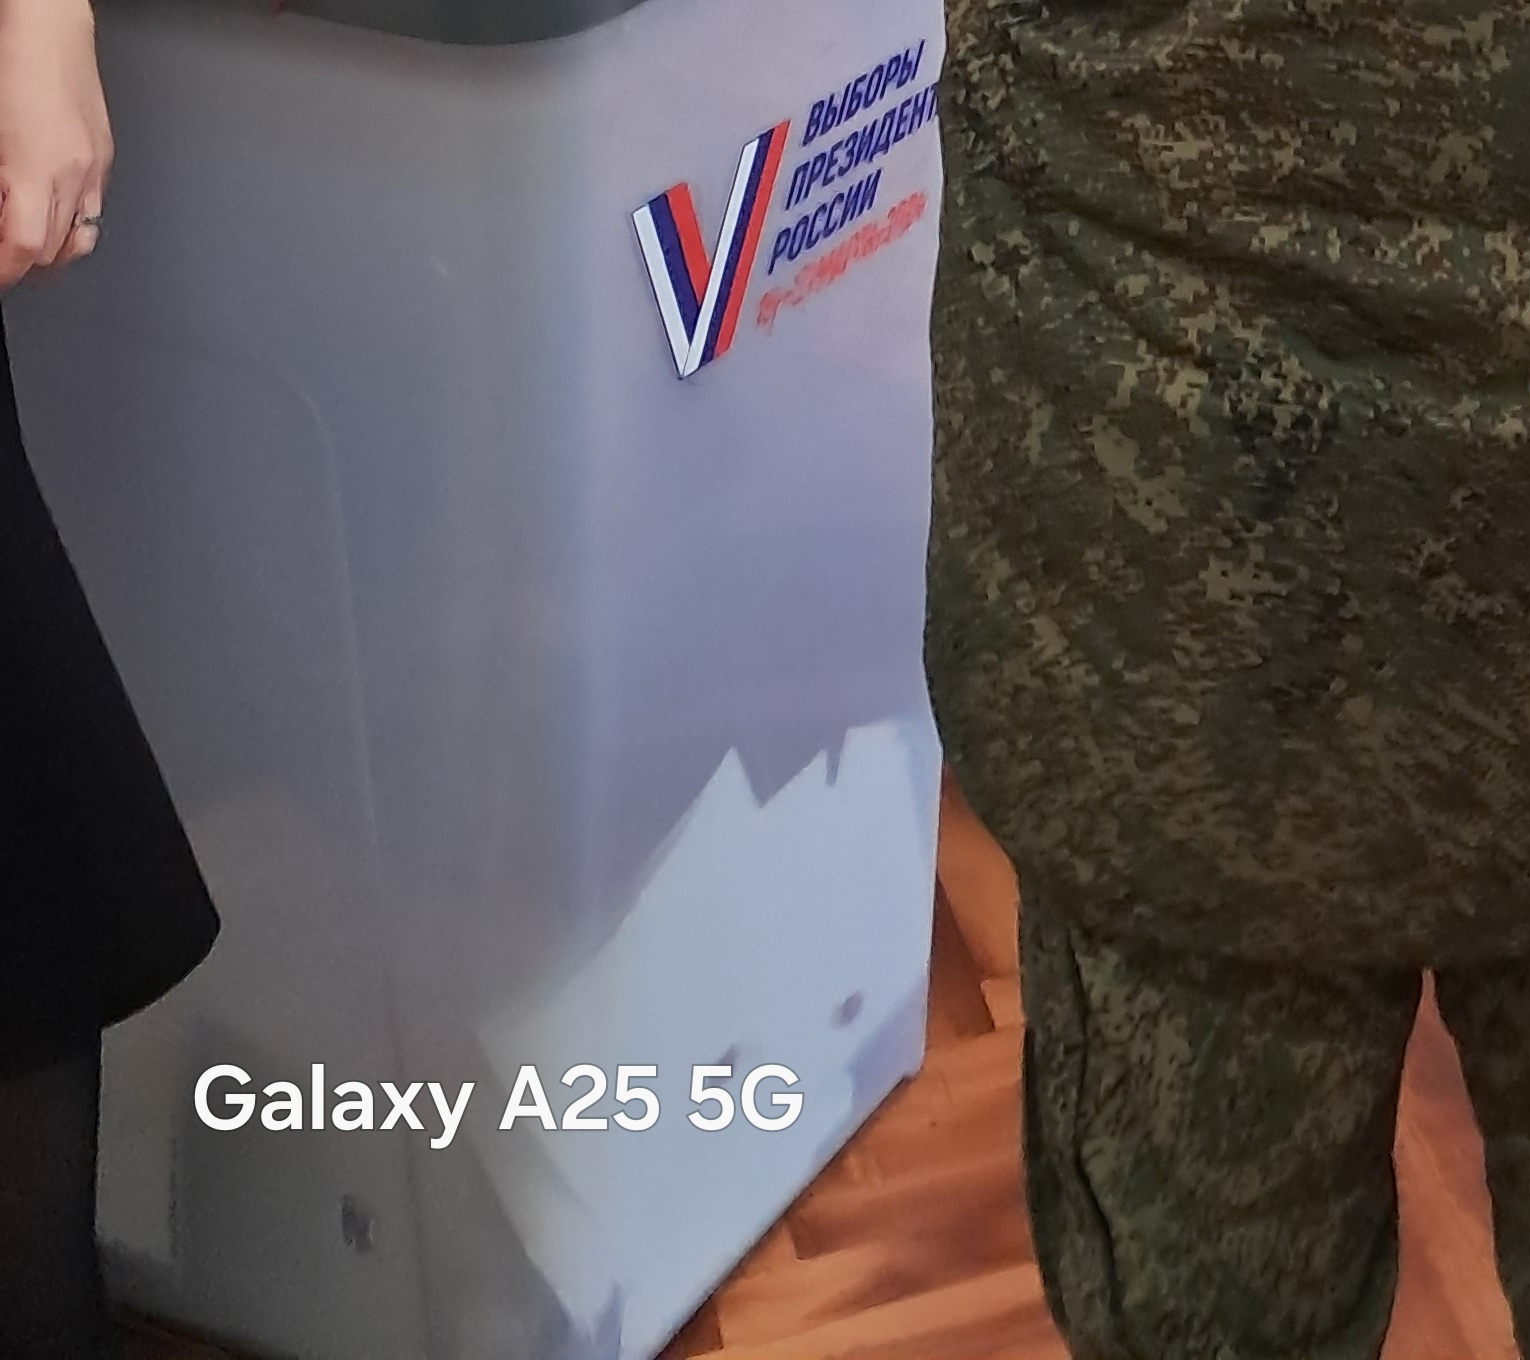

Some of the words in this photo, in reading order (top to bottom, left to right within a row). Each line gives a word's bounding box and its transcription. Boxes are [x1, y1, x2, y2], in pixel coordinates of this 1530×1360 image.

[785, 82, 940, 211] ПРЕЗИДЕНТ
[802, 38, 925, 147] ВЫБОРЫ
[767, 167, 882, 276] РОССИИ
